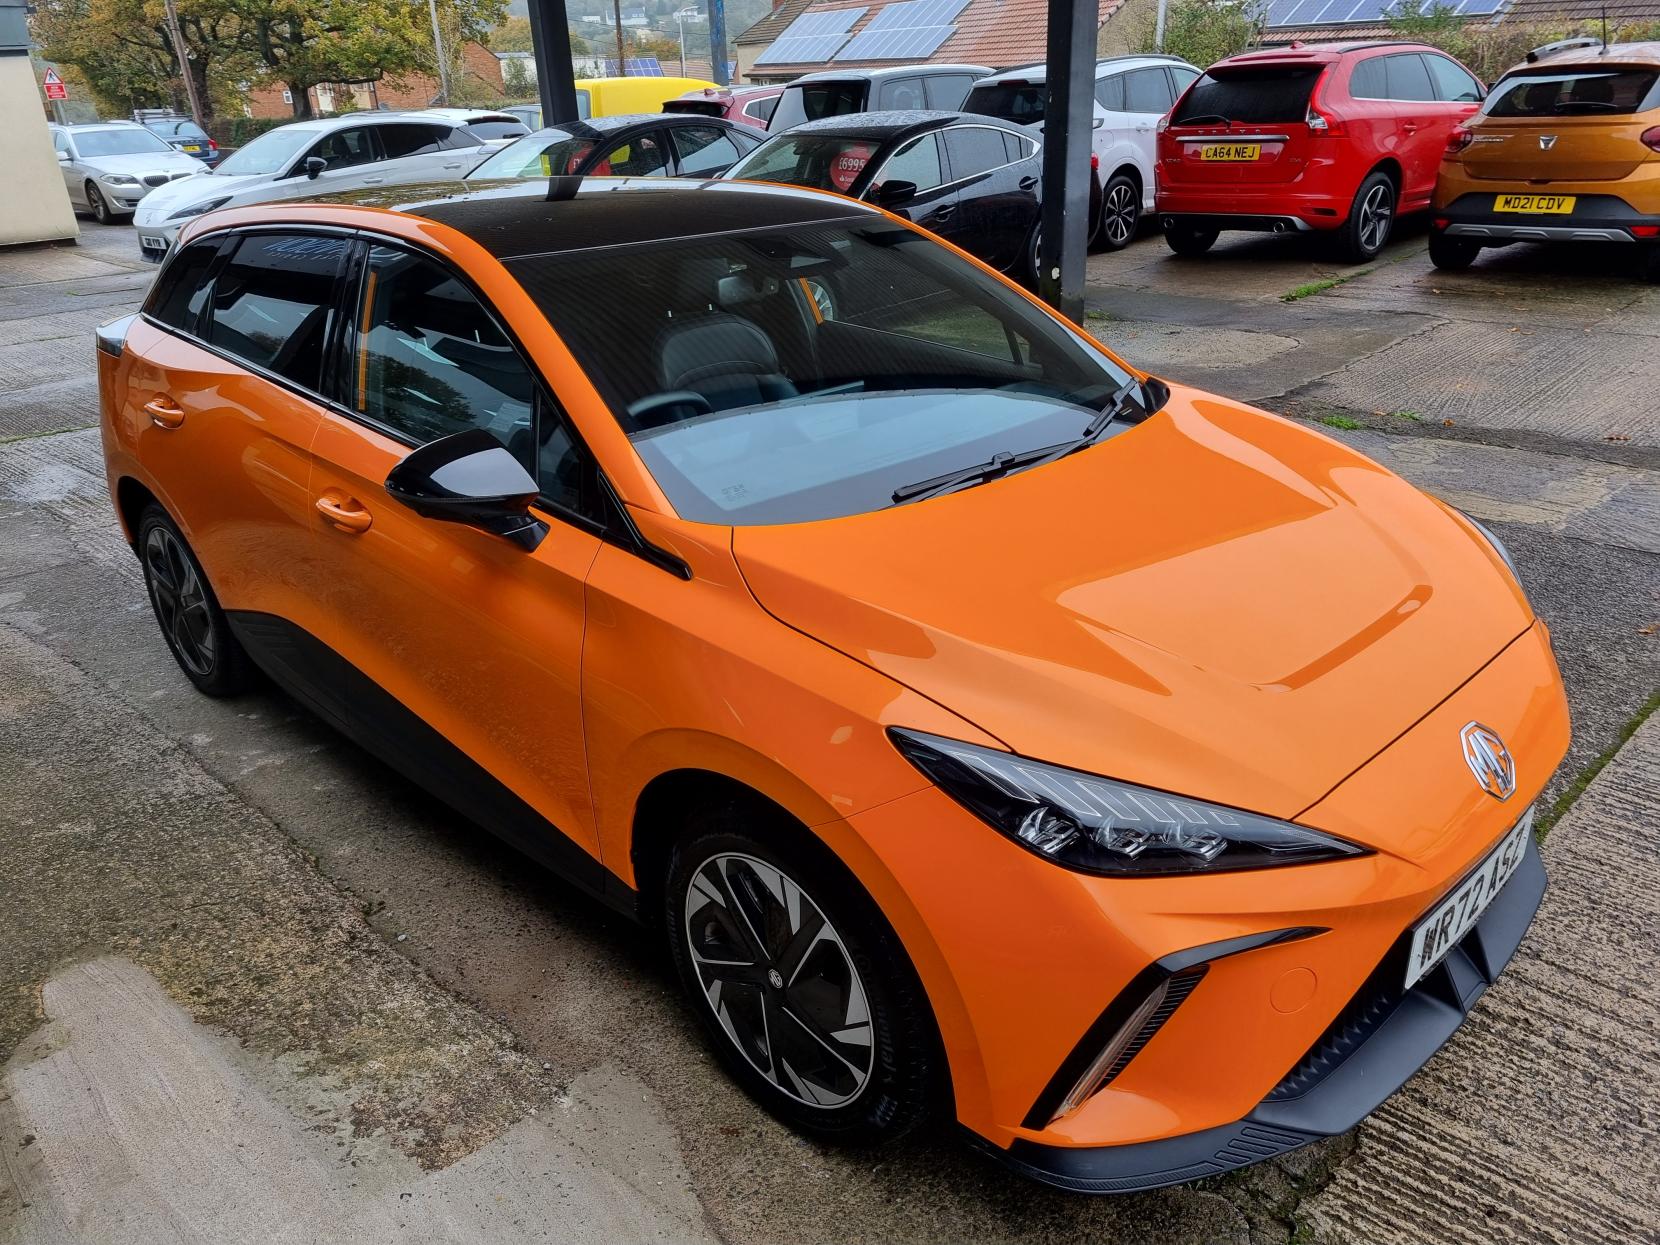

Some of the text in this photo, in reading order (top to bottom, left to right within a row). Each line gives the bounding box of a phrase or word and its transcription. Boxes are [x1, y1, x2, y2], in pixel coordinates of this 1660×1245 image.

[1205, 147, 1256, 159] CA64 NEJ
[839, 157, 866, 172] £6995
[1502, 196, 1566, 210] MD21 CDV
[1467, 729, 1513, 794] MG
[1420, 823, 1526, 969] WR72 ASZ
